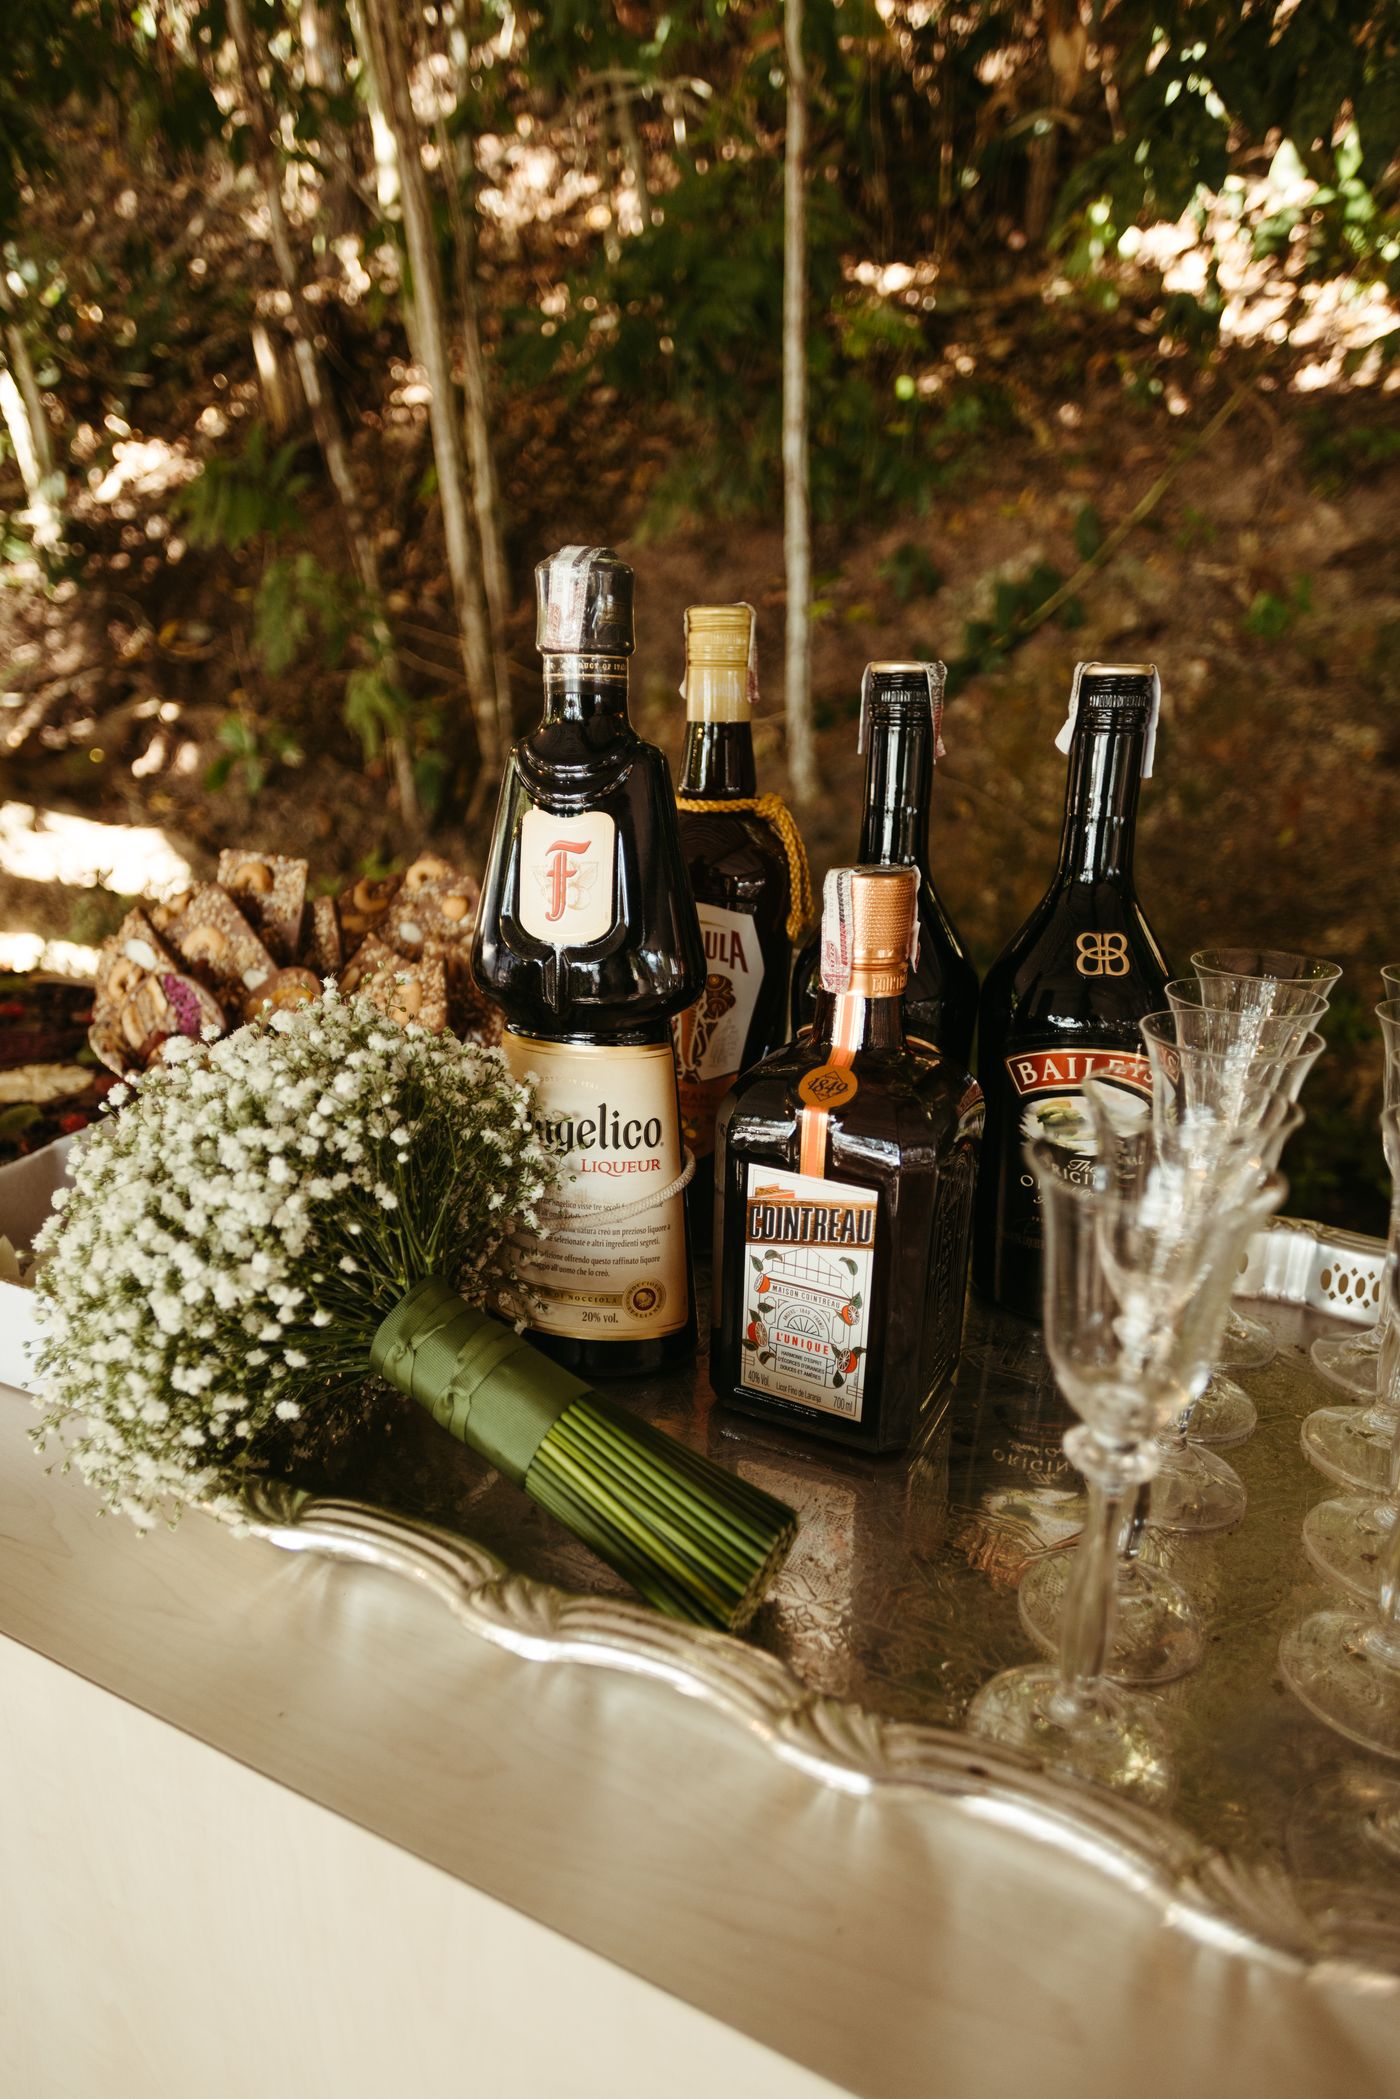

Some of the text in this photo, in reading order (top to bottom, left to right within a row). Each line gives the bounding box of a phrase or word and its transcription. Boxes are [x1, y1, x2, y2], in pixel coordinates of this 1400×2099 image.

[807, 1077, 848, 1095] 1849
[581, 1158, 661, 1177] LIQUEUR
[751, 1204, 874, 1244] COINTREAU
[622, 1227, 646, 1237] prezioso
[592, 1239, 604, 1247] altri
[605, 1238, 638, 1249] ingredienti
[564, 1253, 590, 1264] offrendo
[591, 1257, 611, 1267] questo
[612, 1256, 639, 1265] raffinato
[640, 1255, 661, 1266] liquore
[577, 1266, 587, 1276] che
[588, 1268, 594, 1276] lo
[568, 1295, 617, 1304] NOCCIOLA
[772, 1285, 841, 1309] MAISON COINTREAU
[582, 1311, 619, 1324] 20% vol.
[776, 1331, 829, 1356] L'UNIQUE
[833, 1396, 845, 1410] 700
